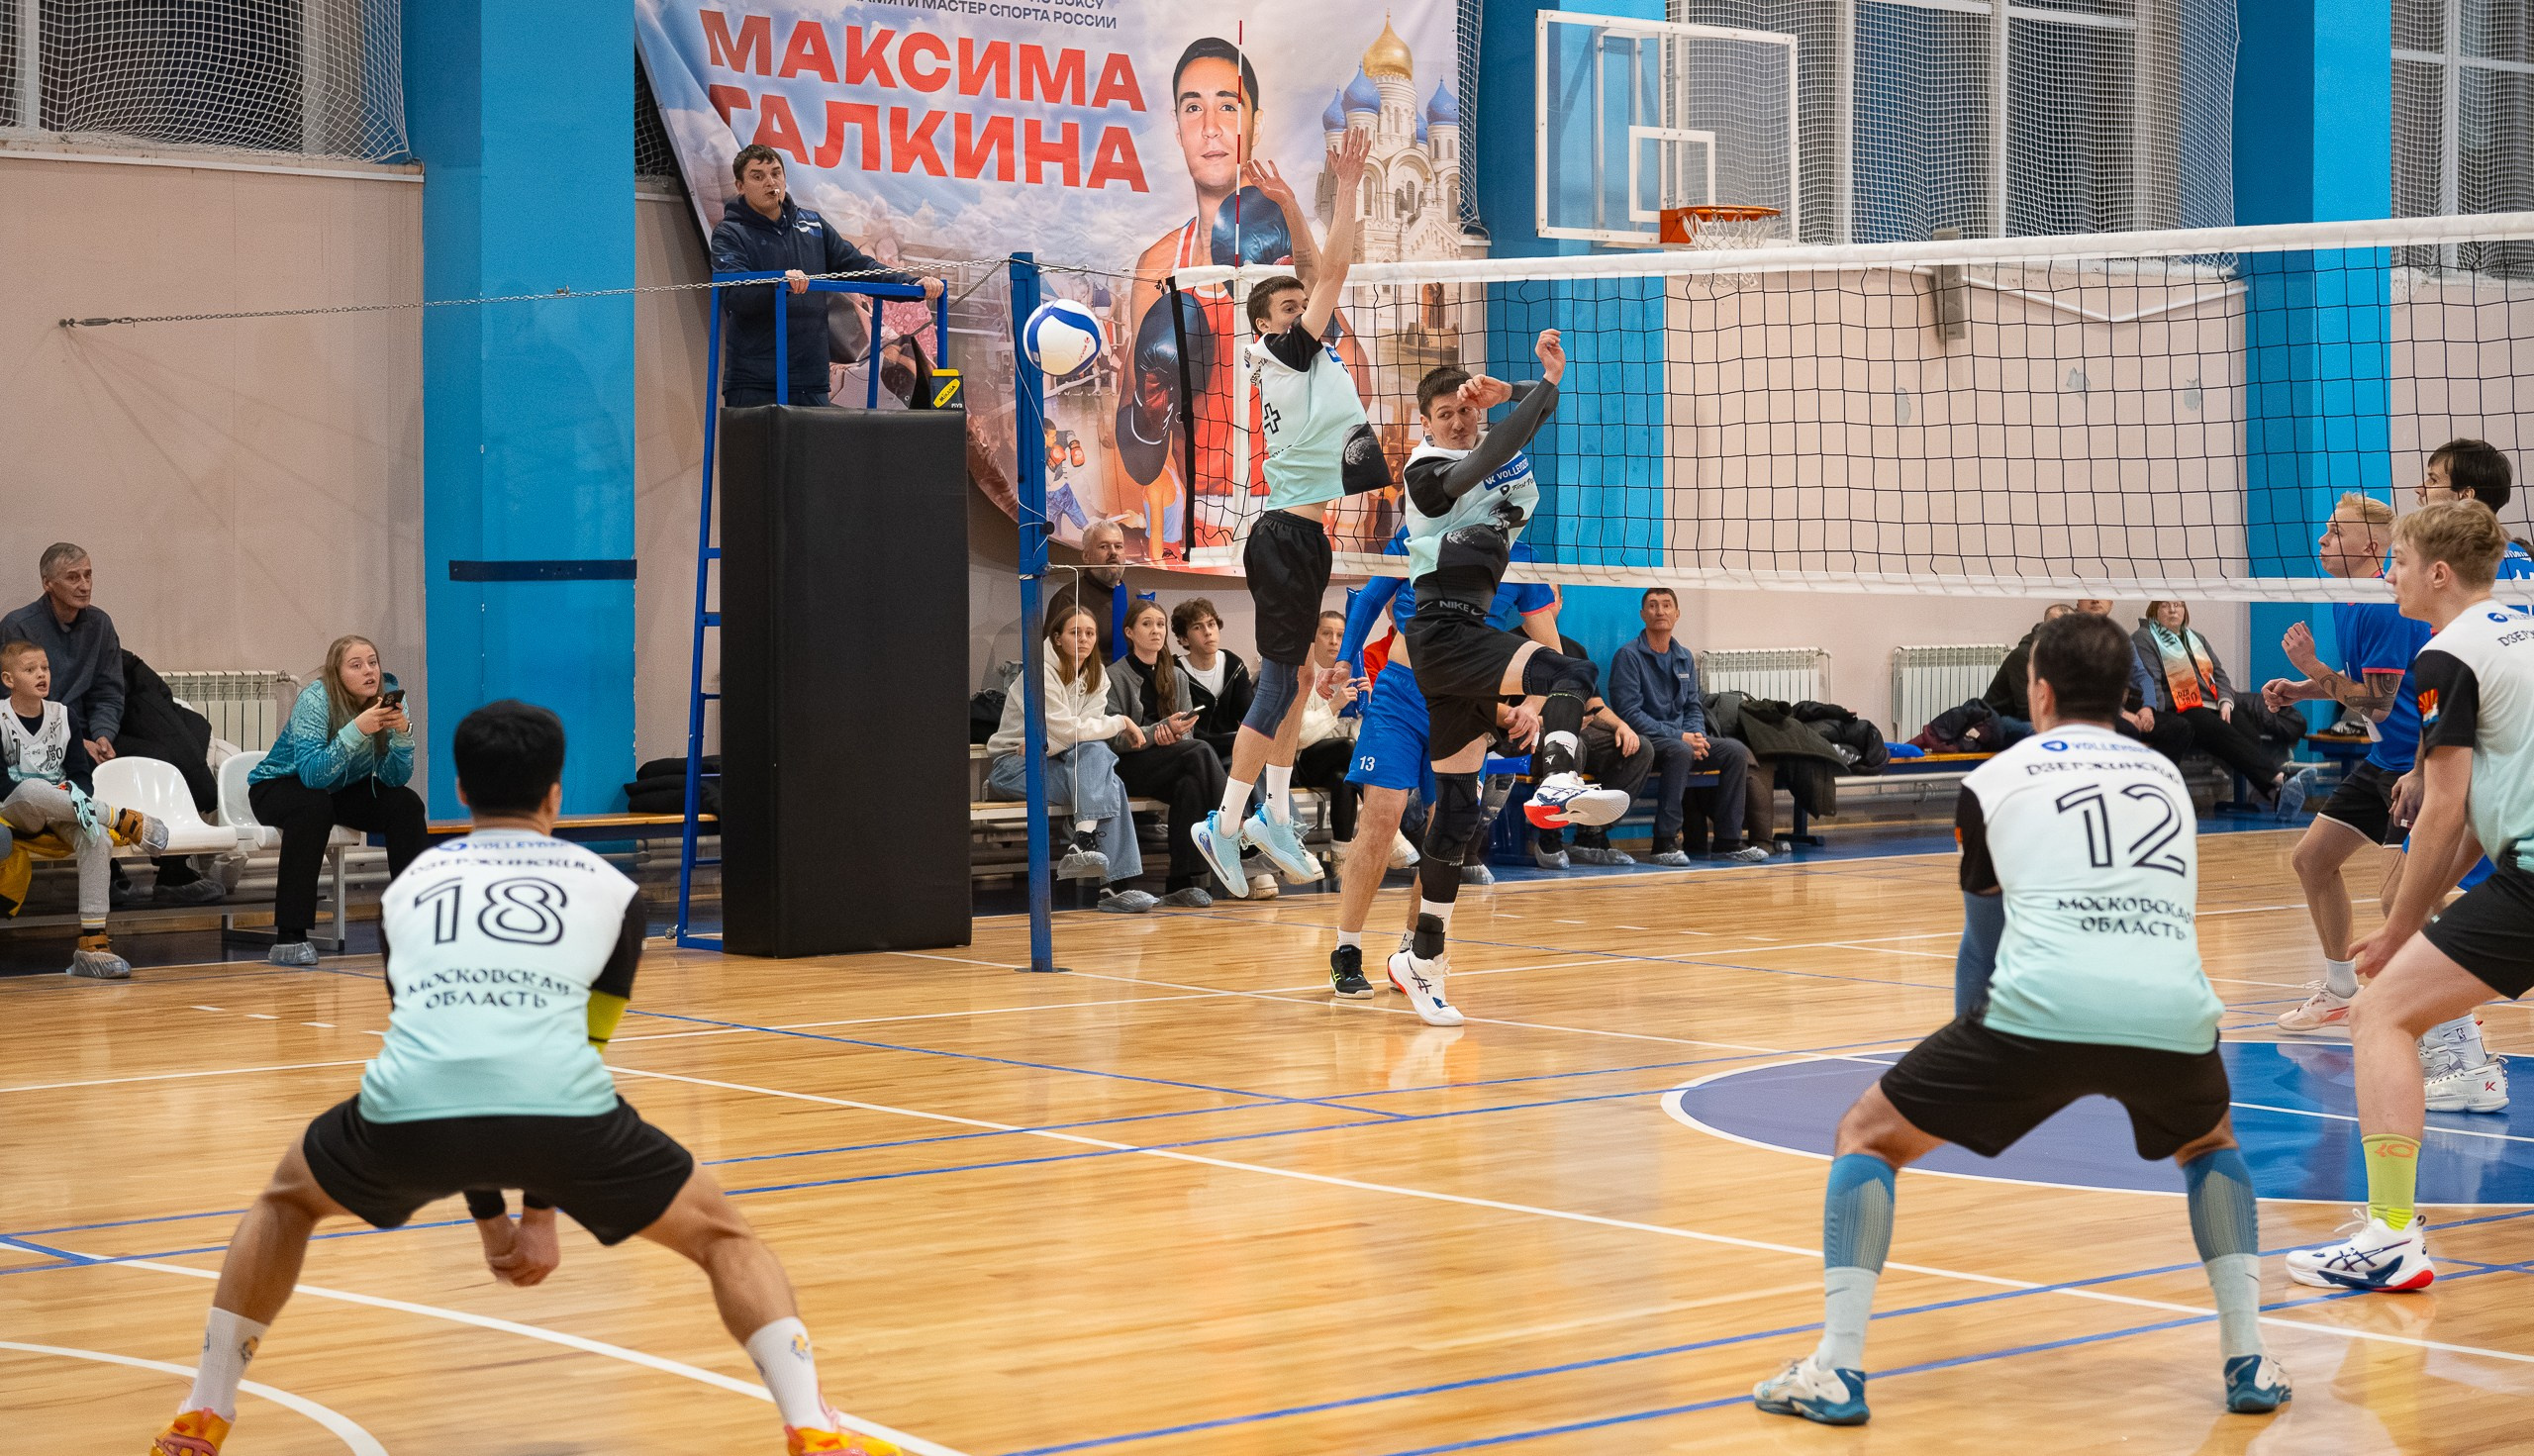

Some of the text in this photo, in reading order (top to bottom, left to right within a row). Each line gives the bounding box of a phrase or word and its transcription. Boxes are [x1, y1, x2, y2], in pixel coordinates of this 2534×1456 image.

[922, 0, 987, 15] МАСТЕР
[990, 4, 1051, 22] СПОРТА
[1053, 11, 1117, 29] РОССИИ
[700, 9, 1147, 112] МАКСИМА
[1439, 600, 1469, 613] NIKE
[1359, 755, 1376, 772] 13
[2055, 783, 2187, 878] 12
[414, 876, 568, 946] 18
[2081, 917, 2187, 940] ОБЛАСТЬ
[426, 991, 548, 1010] ОБЛАСТЬ
